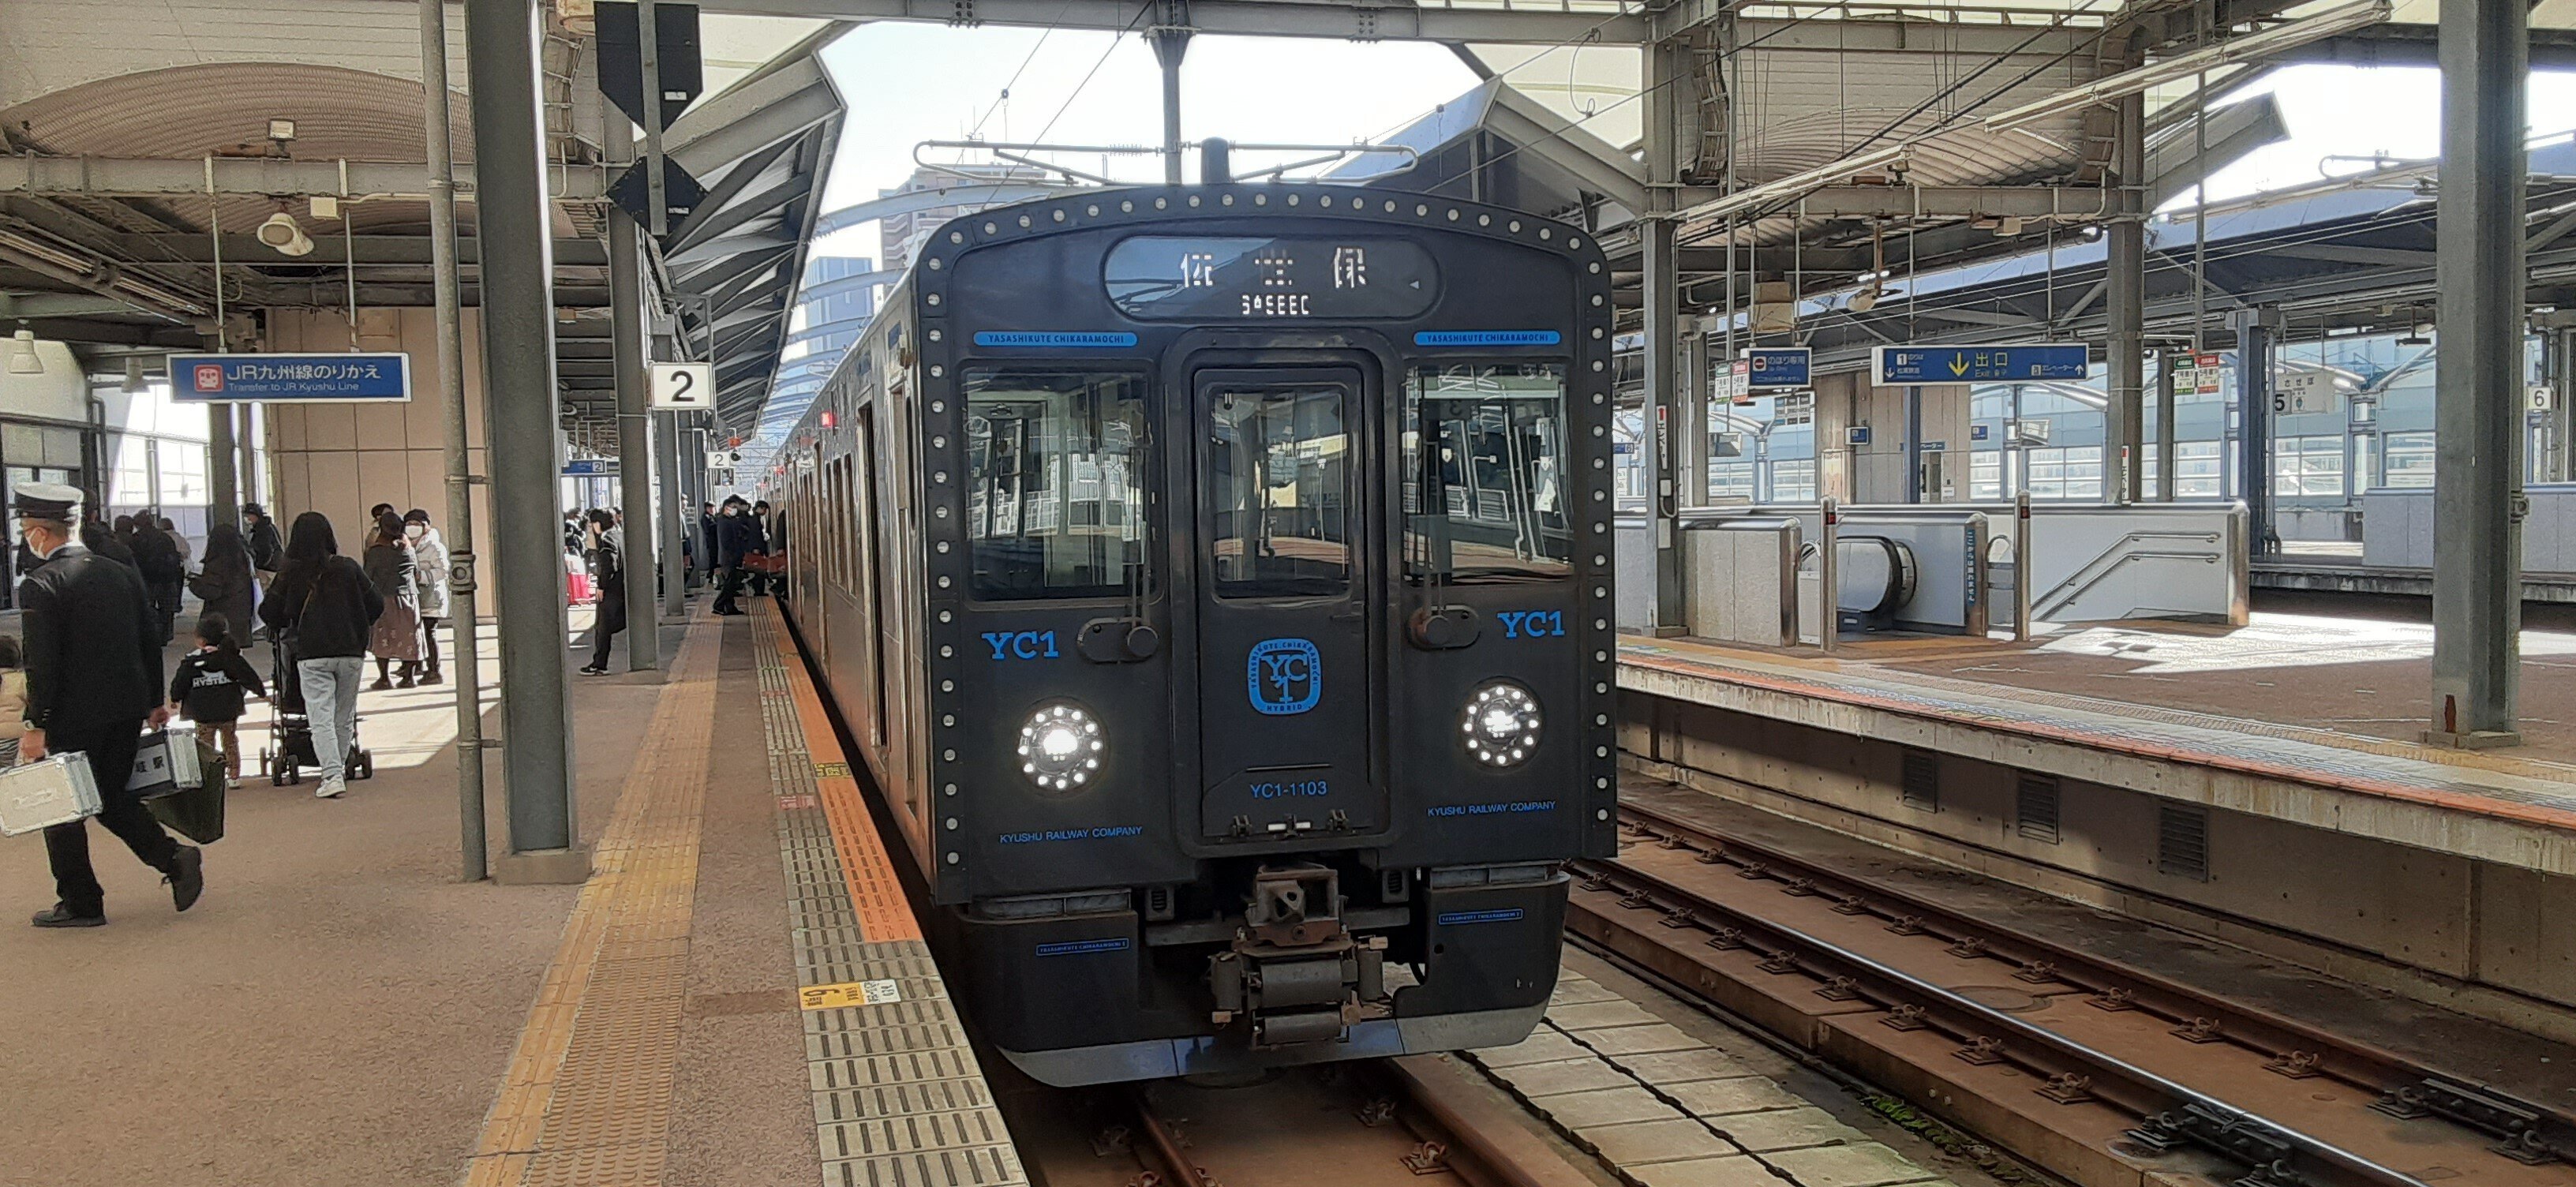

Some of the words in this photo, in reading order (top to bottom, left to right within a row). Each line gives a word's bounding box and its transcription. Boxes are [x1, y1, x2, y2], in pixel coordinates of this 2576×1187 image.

[988, 334, 1051, 343] YASASHIKUTE
[1054, 334, 1125, 343] CHIKARAMOCHI
[1427, 334, 1483, 343] YASASHIKUTE
[1485, 334, 1548, 343] CHIKARAMOCHI
[1975, 351, 2008, 367] 出口
[227, 365, 381, 380] JR九州線のりかえ
[228, 382, 268, 391] Transfer
[271, 383, 280, 391] to
[283, 383, 297, 391] JR
[299, 383, 336, 393] Kyushu
[338, 382, 360, 391] Line
[670, 370, 695, 402] 2
[2275, 394, 2286, 411] 5
[2534, 390, 2544, 407] 6
[714, 454, 724, 466] 2
[1496, 610, 1566, 638] YC1
[981, 631, 1059, 659] YC1
[1249, 781, 1327, 799] YC1-1103
[1427, 807, 1466, 817] KYUSHU
[1469, 803, 1508, 814] RAILWAY
[1510, 801, 1556, 812] COMPANY
[999, 832, 1043, 843] KYUSHU
[1046, 829, 1089, 841] RAILWAY
[1091, 826, 1143, 837] COMPANY
